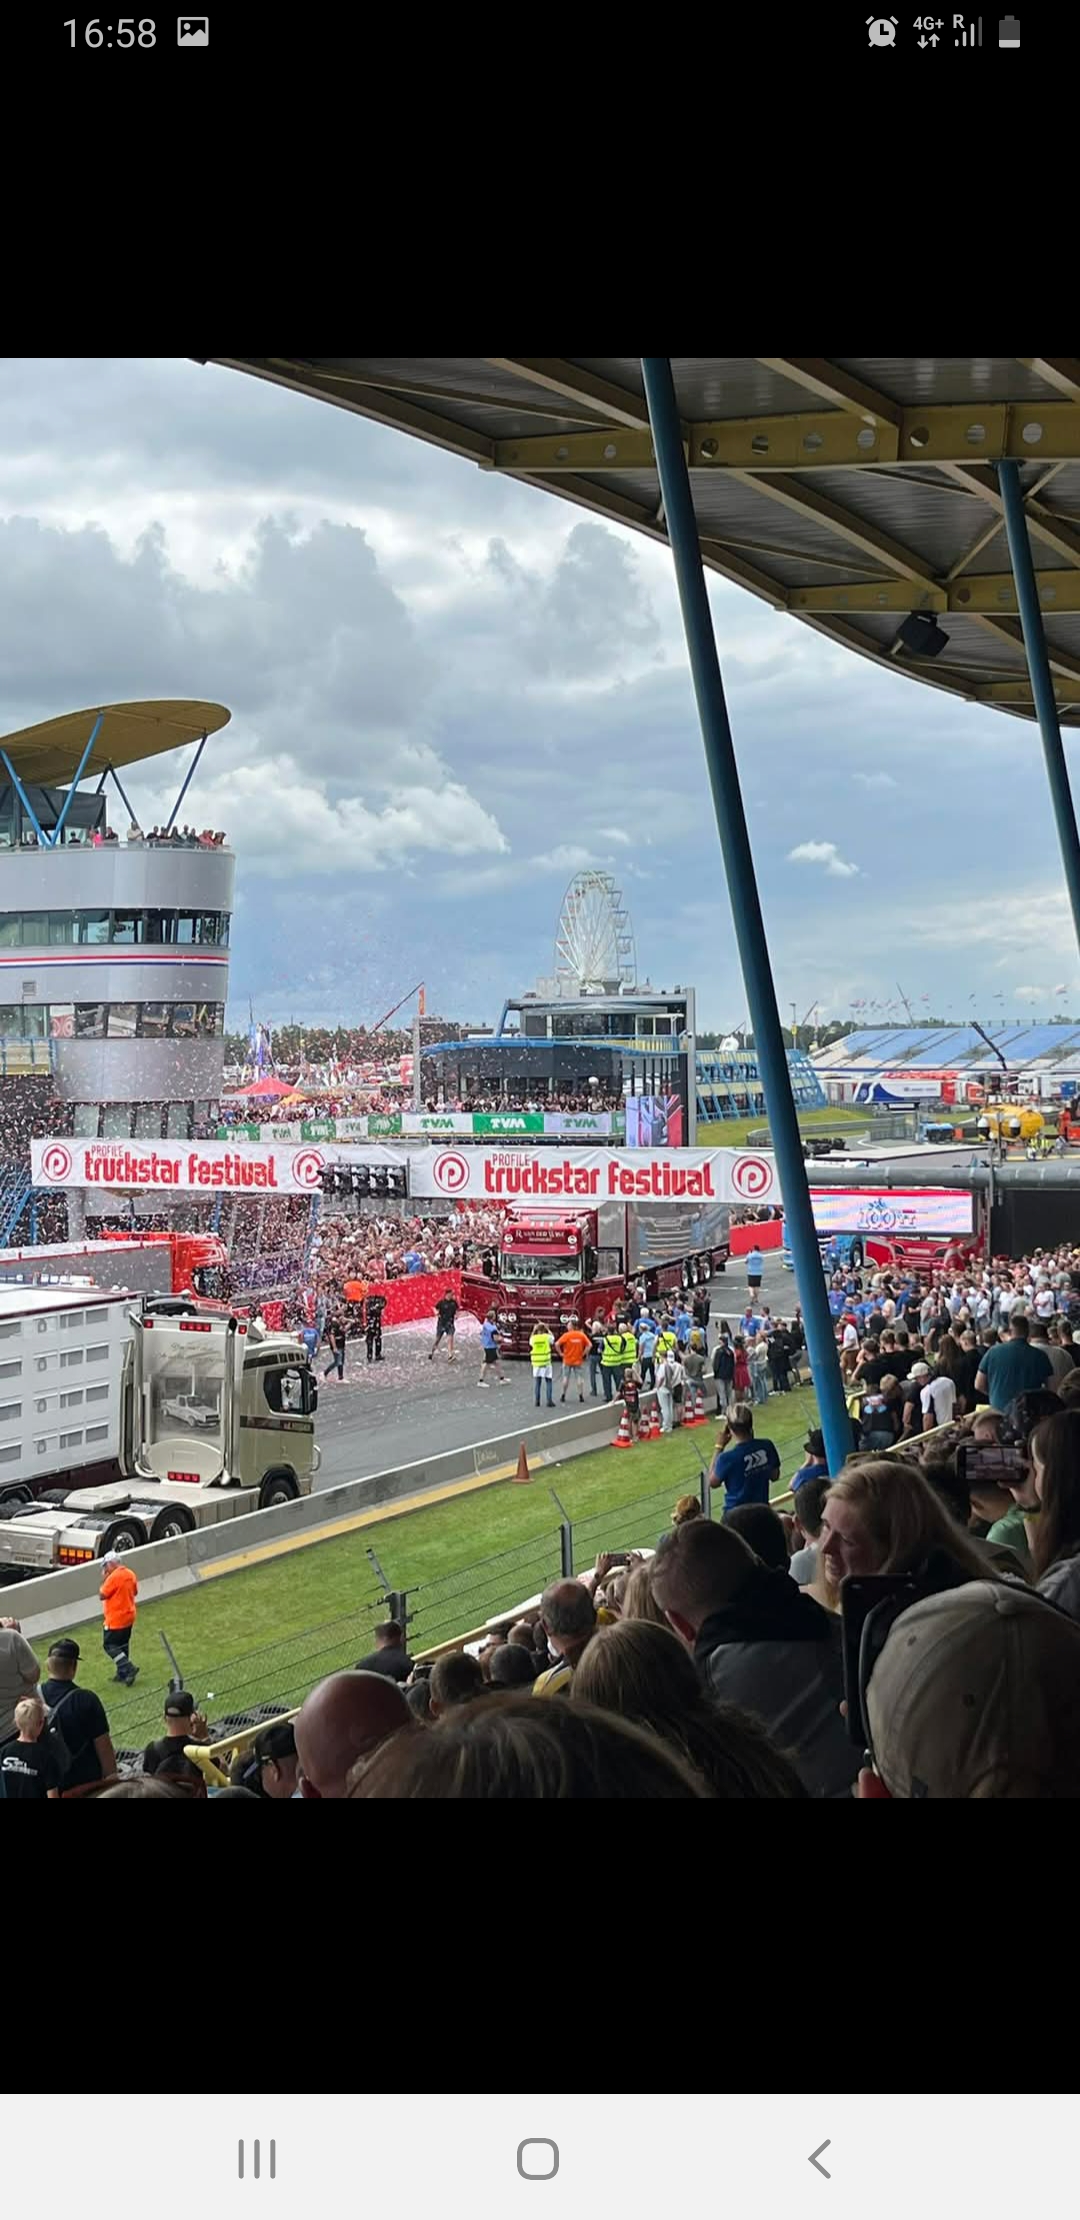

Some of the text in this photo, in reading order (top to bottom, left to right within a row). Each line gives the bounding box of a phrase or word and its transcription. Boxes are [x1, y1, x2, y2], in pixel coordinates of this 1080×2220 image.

[419, 1118, 455, 1129] TVM
[490, 1118, 527, 1129] TVM
[563, 1118, 598, 1129] TVM
[91, 1144, 124, 1157] PROFILE
[491, 1153, 531, 1167] PROFILE
[84, 1150, 183, 1184] truckstar
[484, 1159, 601, 1195] truckstar
